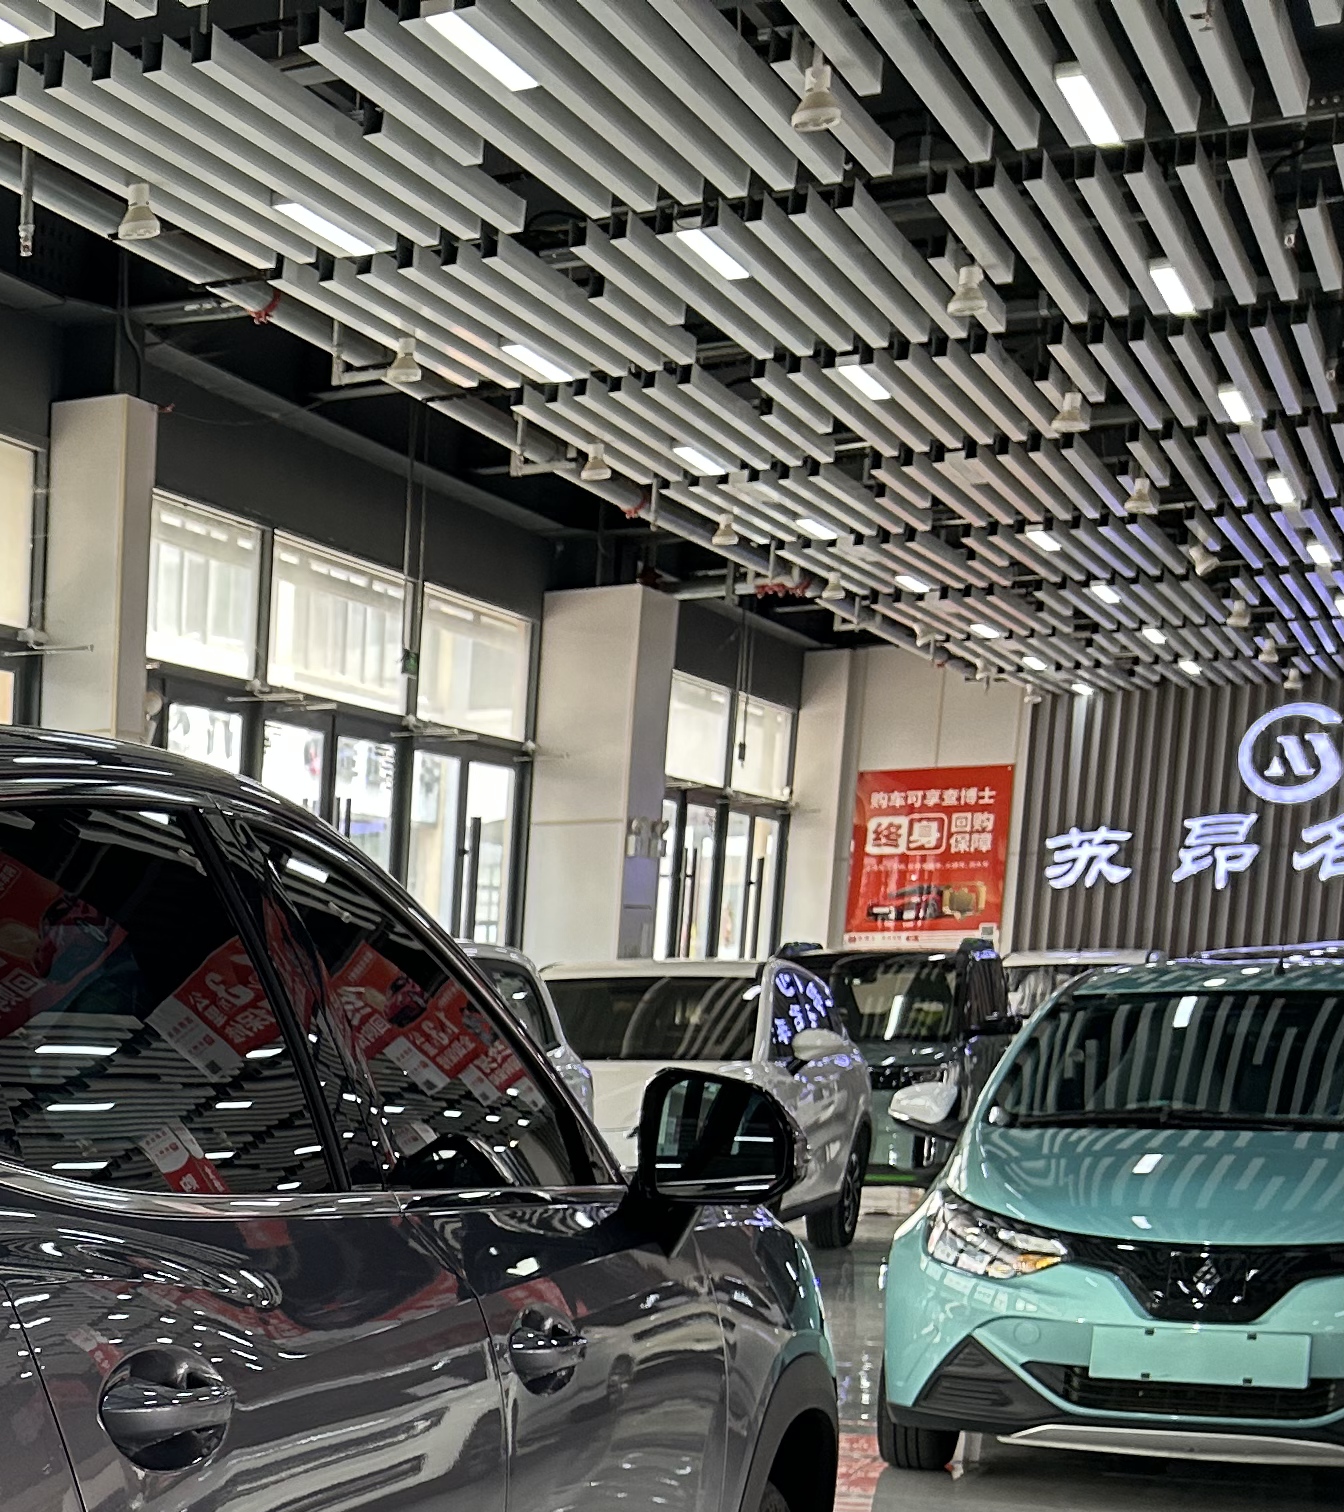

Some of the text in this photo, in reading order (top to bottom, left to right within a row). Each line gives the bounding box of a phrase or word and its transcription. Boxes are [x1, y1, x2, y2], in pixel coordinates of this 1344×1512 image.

[869, 786, 997, 810] 购车可享查博士
[950, 811, 995, 833] 回购
[872, 819, 941, 850] 终身
[949, 832, 993, 854] 保障
